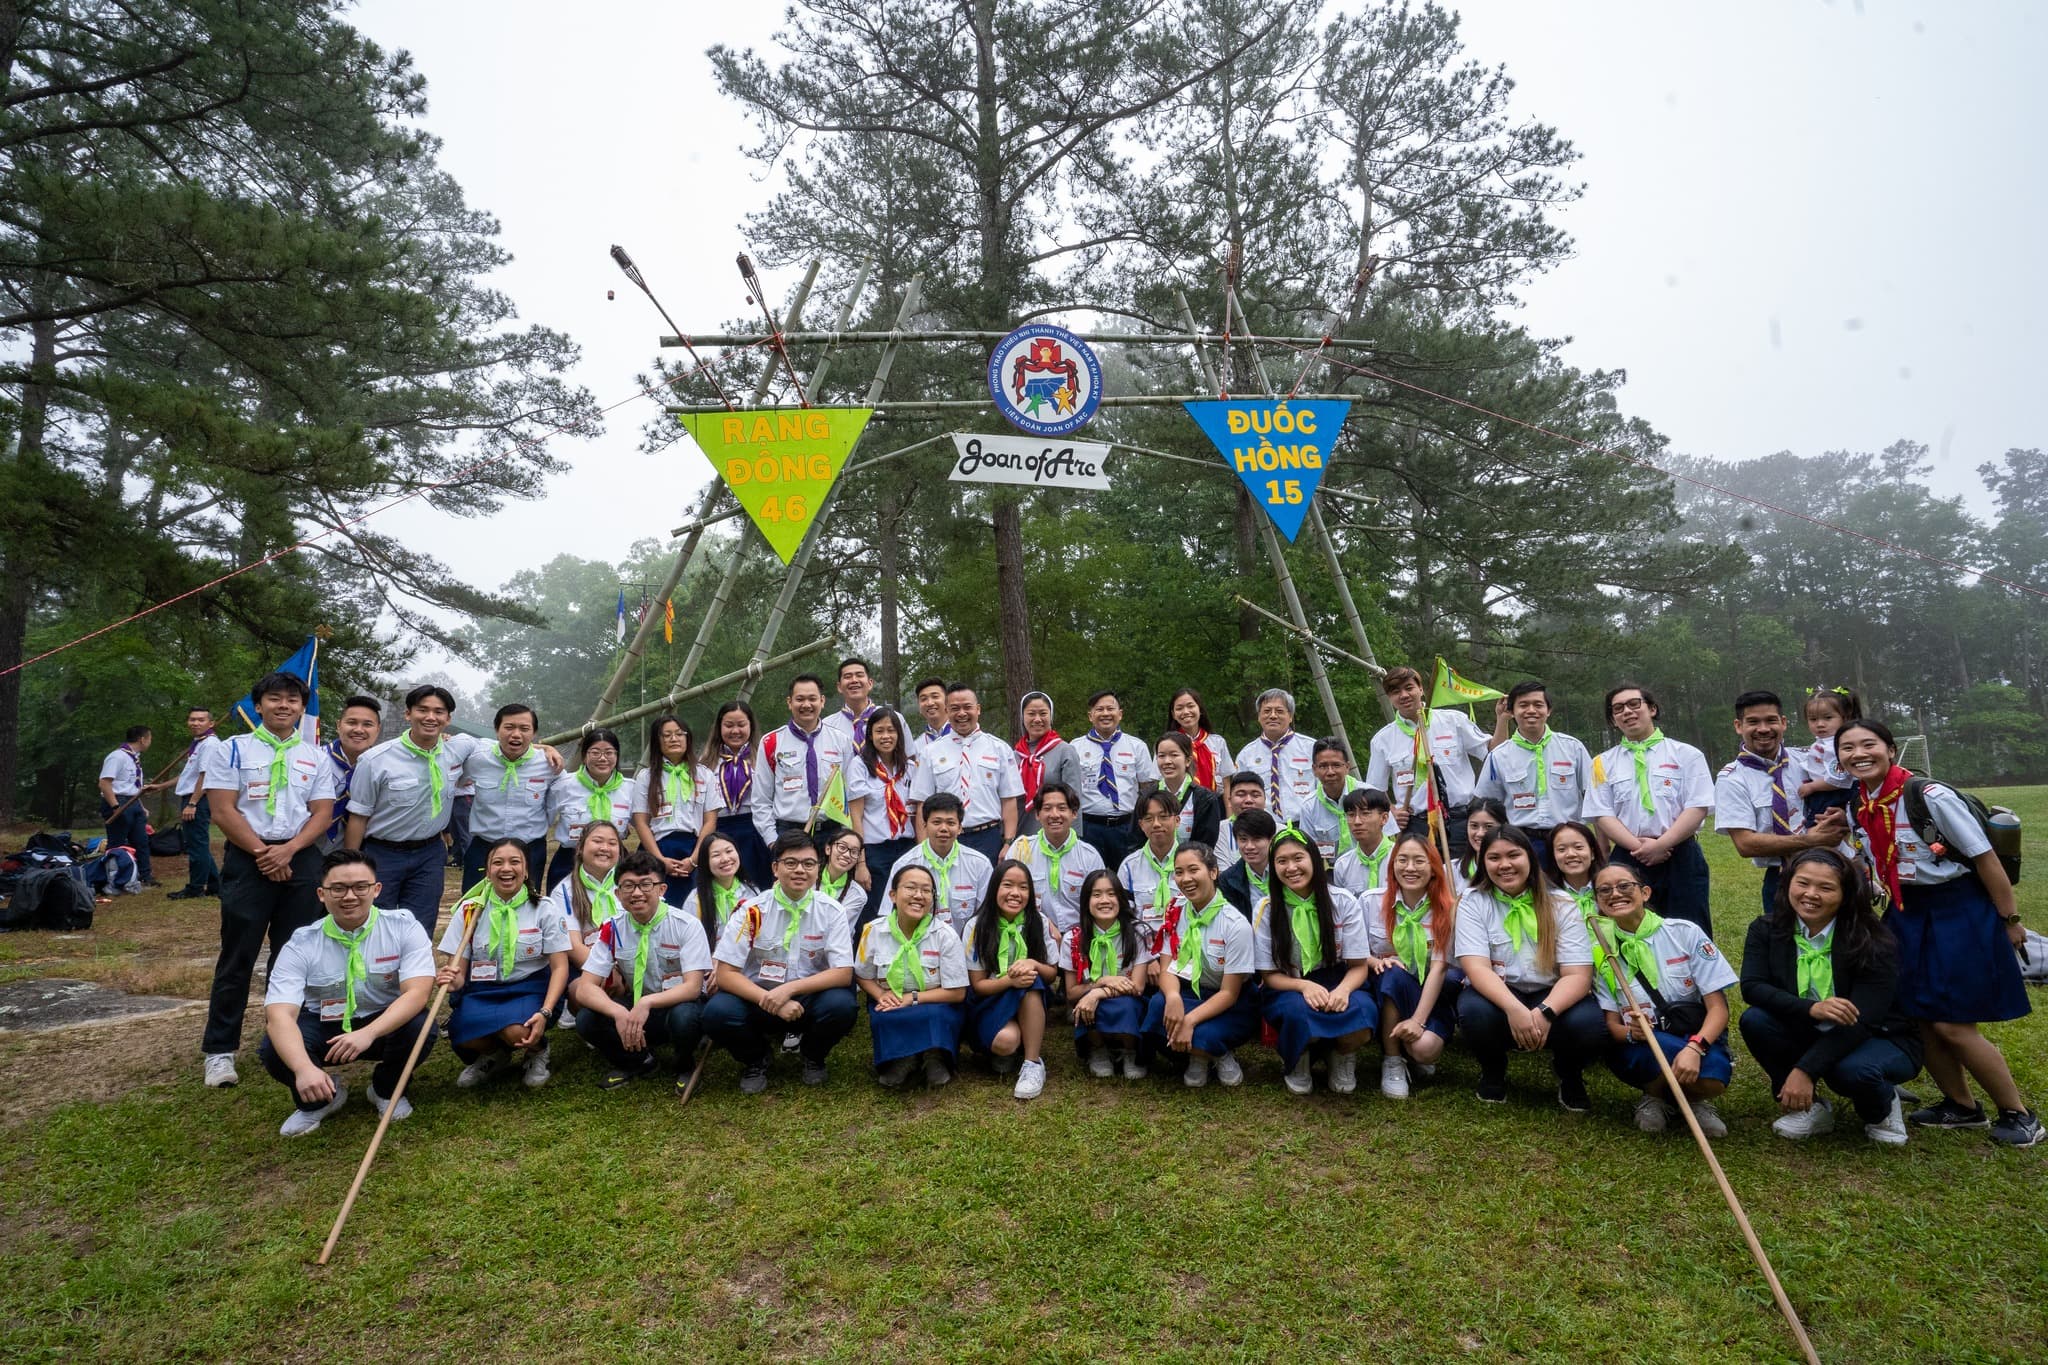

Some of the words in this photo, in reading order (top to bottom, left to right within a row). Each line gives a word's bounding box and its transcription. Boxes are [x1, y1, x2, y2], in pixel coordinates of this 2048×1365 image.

[1064, 422, 1074, 430] OF
[1075, 411, 1088, 424] ARC
[958, 439, 1022, 475] Joan
[1025, 448, 1052, 482] of
[1044, 448, 1096, 479] Arc
[1234, 435, 1322, 472] HỒNG
[726, 450, 833, 486] ĐÔNG
[1265, 480, 1303, 504] 15
[759, 495, 808, 523] 46
[1441, 680, 1483, 696] ZDKIEL
